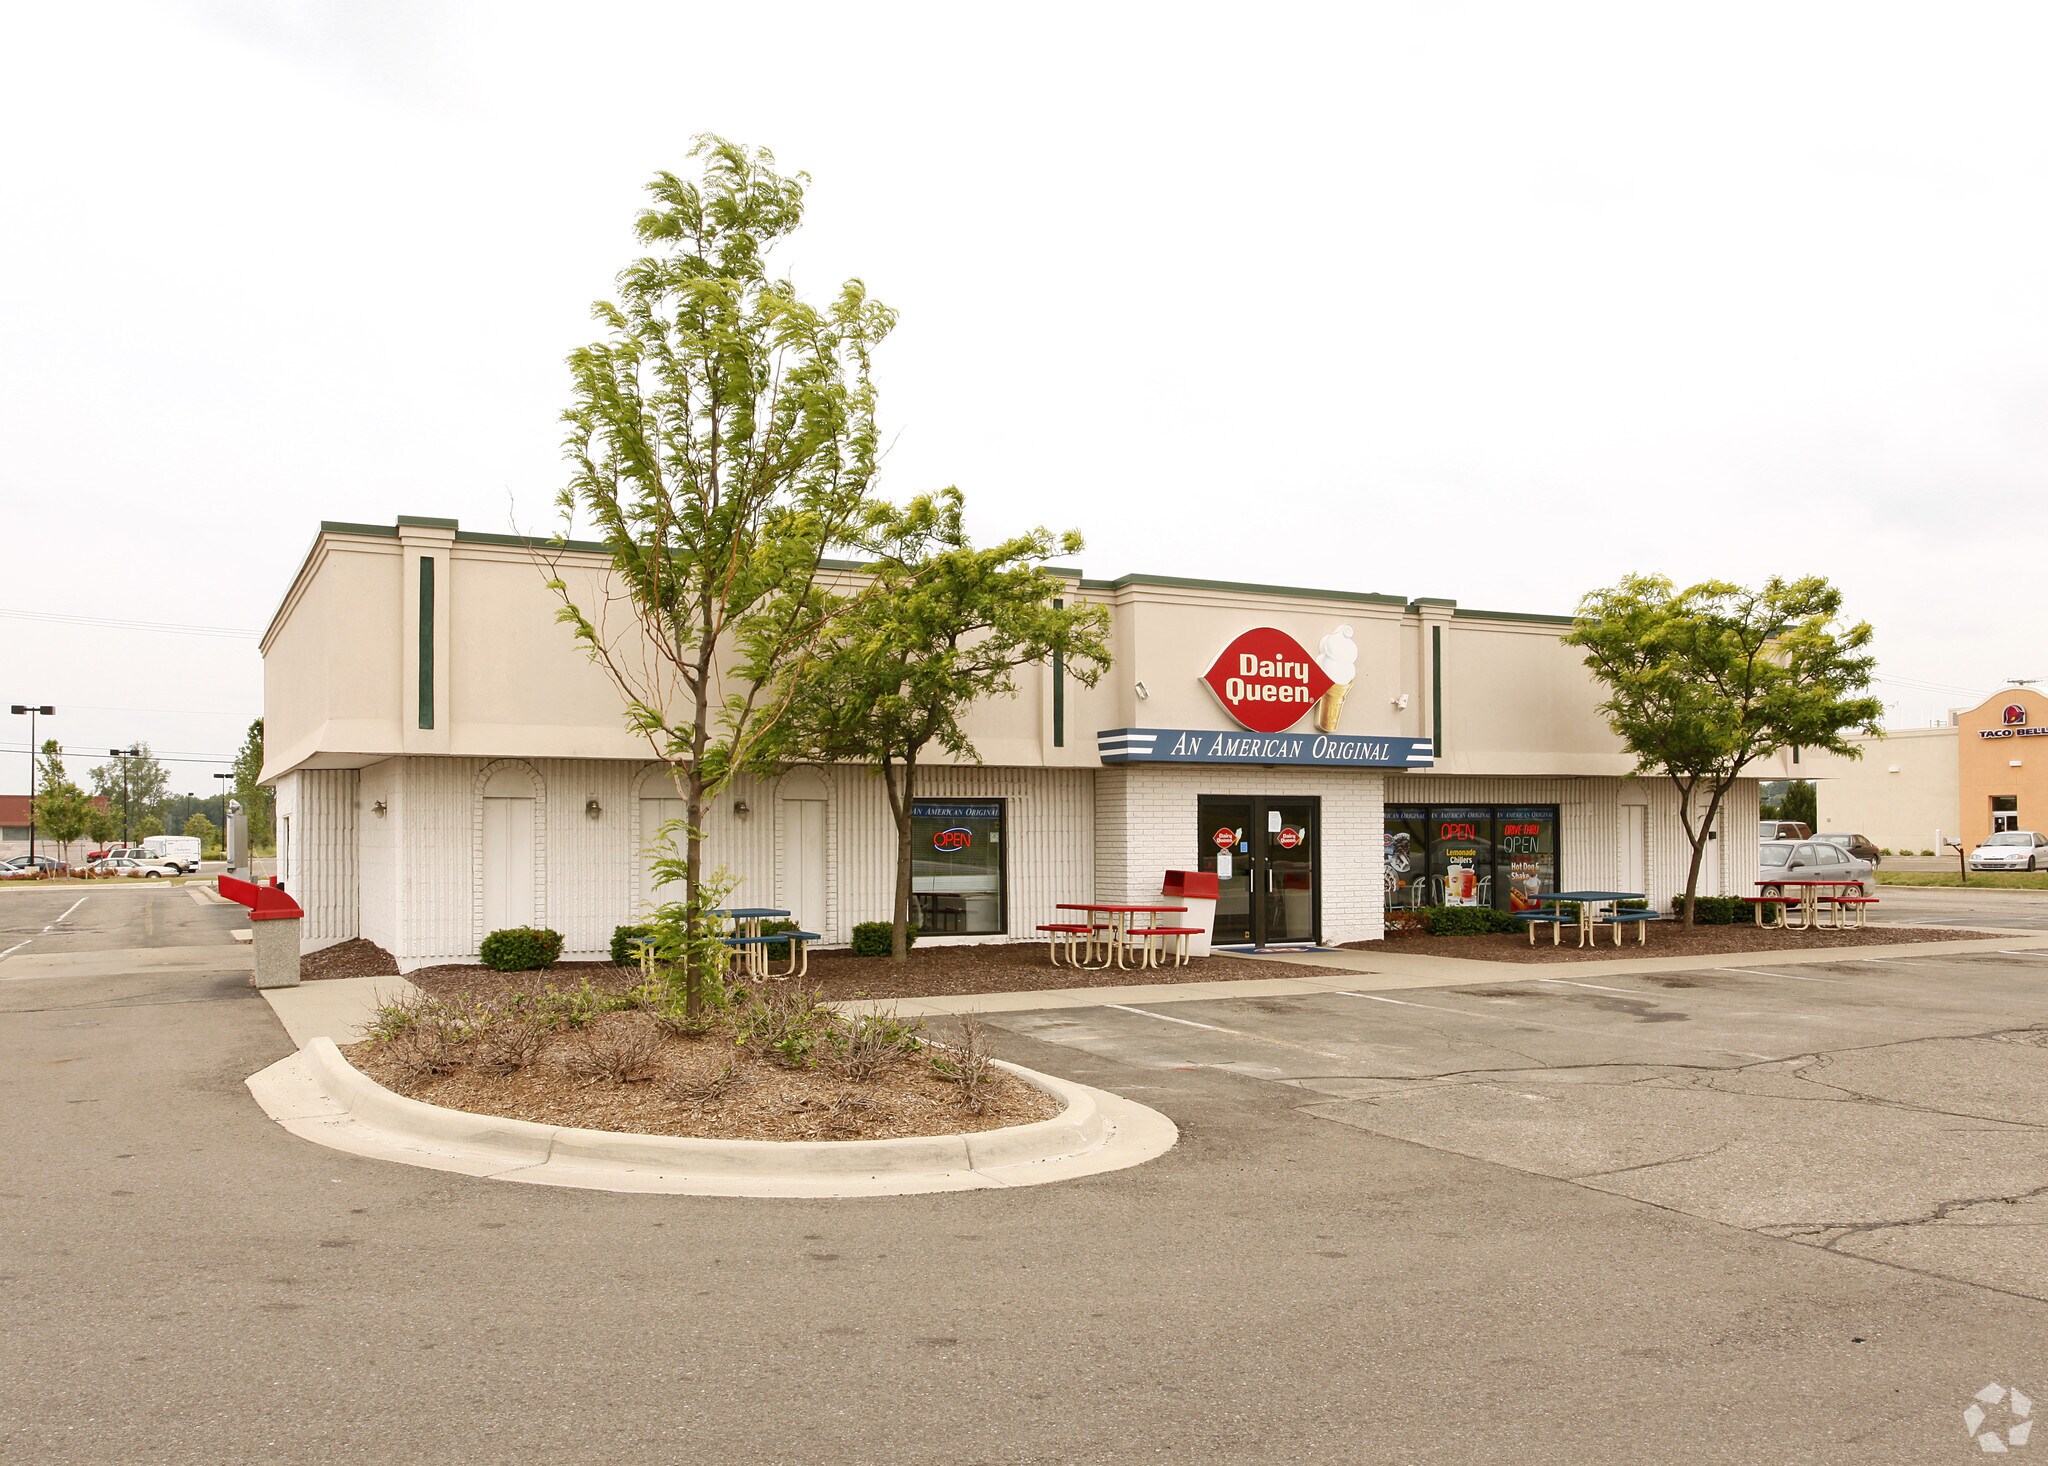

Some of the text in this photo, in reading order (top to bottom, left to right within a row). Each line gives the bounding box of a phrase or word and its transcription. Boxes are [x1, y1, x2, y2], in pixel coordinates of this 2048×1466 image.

[1239, 653, 1310, 683] Dairy
[1225, 678, 1310, 705] Queen
[1978, 727, 2048, 738] TACO BELL
[1171, 731, 1390, 761] AN AMERICAN ORIGINAL
[925, 807, 963, 816] AMERICAN
[965, 807, 999, 816] ORIGINAL
[1441, 824, 1475, 840] OPEN
[1504, 824, 1540, 836] DRIVE-THRU
[934, 832, 971, 847] OPEN
[1504, 836, 1539, 853] OPEN
[1446, 848, 1477, 856] Lemonade
[1450, 856, 1473, 864] Chillers
[1511, 862, 1522, 871] Hot
[1523, 862, 1535, 872] Dog
